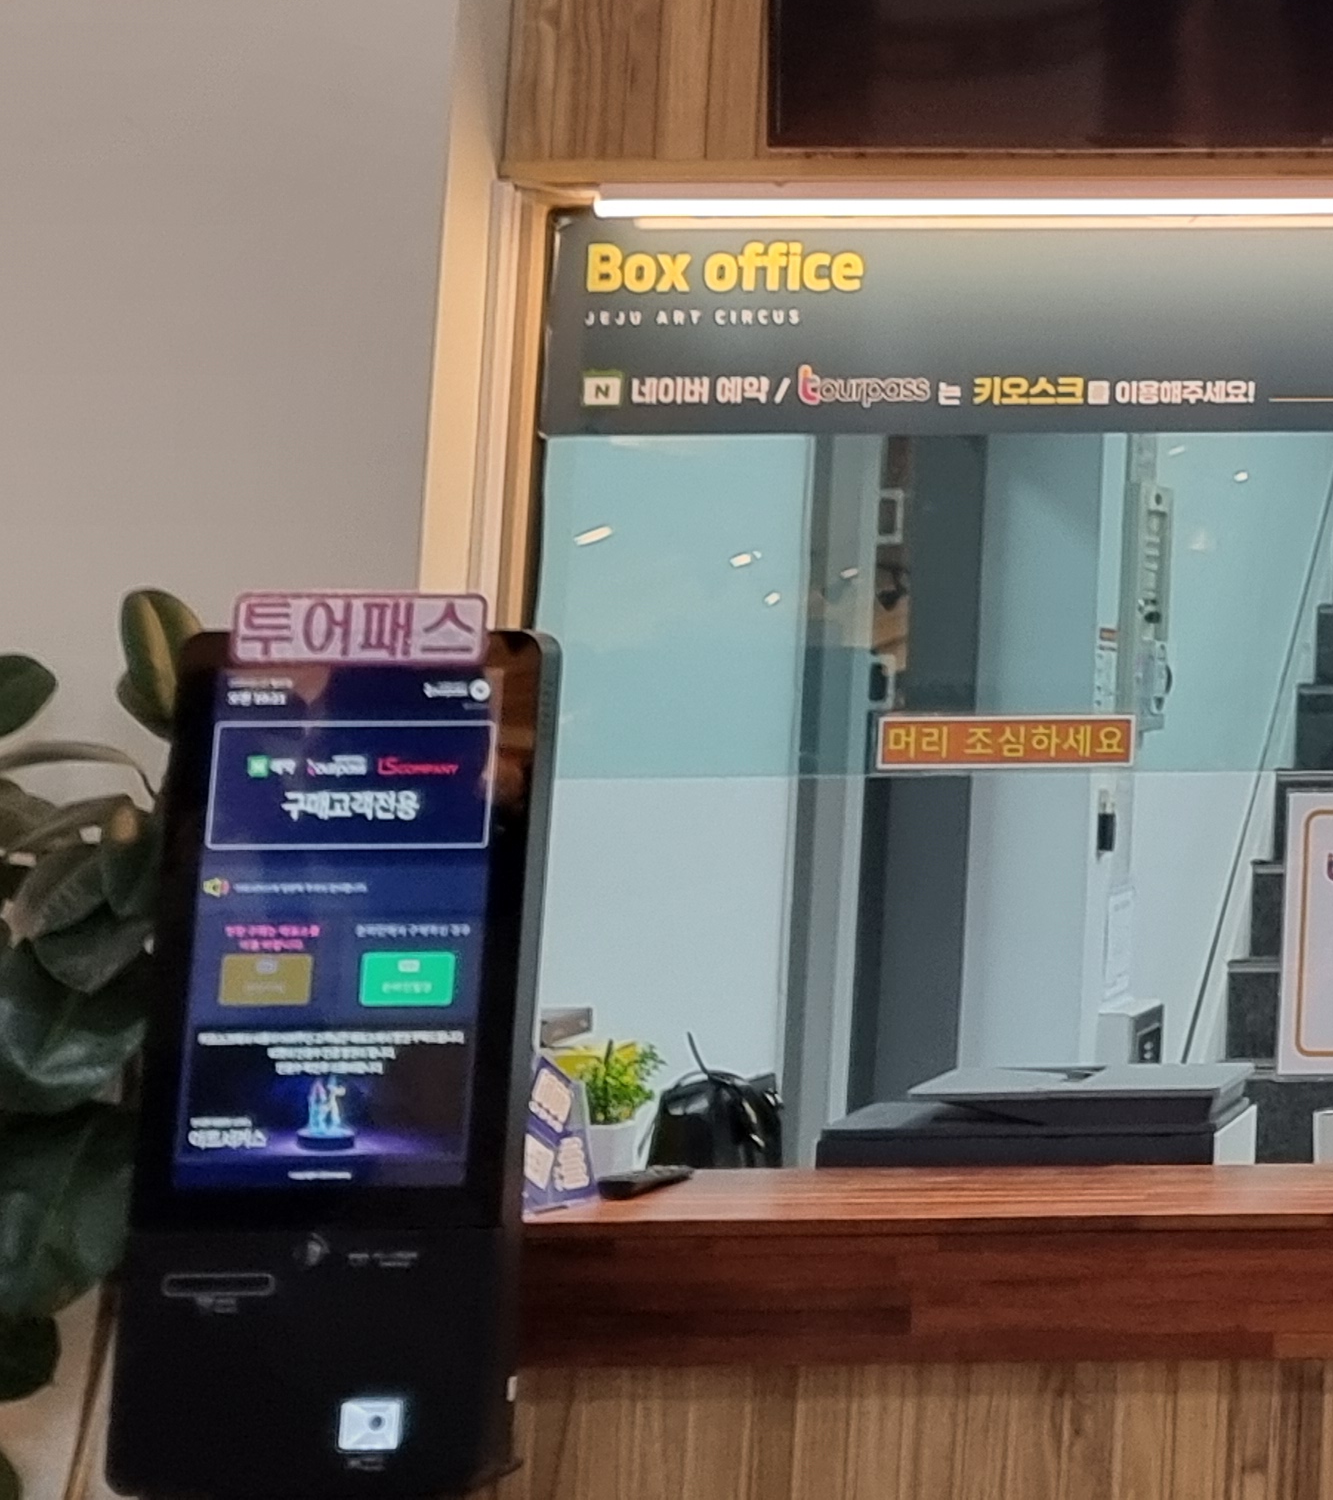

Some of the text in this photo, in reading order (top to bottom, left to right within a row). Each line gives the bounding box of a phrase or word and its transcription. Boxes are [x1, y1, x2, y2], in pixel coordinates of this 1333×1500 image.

[586, 240, 865, 294] Box office
[584, 308, 801, 327] JEJU ART CIRCUS
[631, 376, 710, 406] 네이버
[716, 376, 769, 405] 예약
[798, 364, 931, 407] tourpass
[241, 600, 475, 657] 투어패스
[889, 725, 1125, 758] 머리 조심하세요
